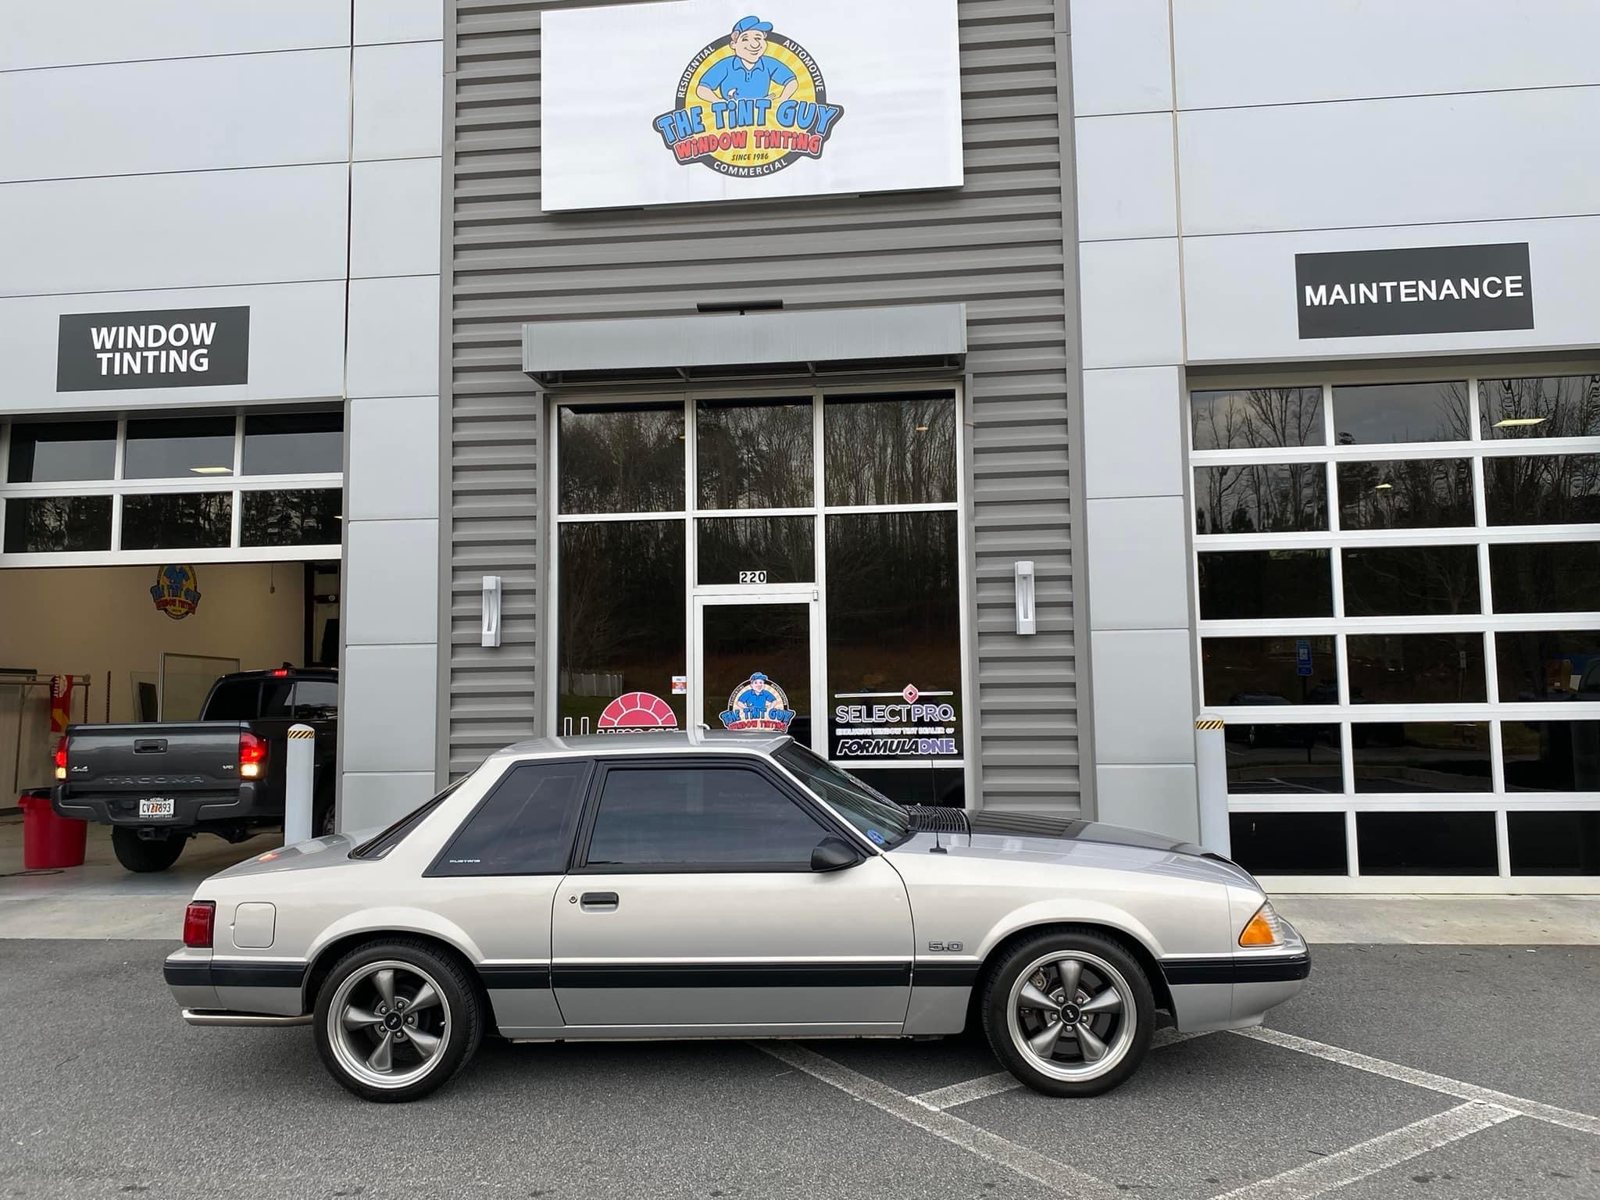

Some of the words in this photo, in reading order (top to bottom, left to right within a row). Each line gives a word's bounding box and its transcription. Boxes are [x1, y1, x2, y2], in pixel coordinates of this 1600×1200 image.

[677, 45, 716, 98] RESIDENTIAL
[783, 39, 824, 93] AUTOMOTIVE
[656, 105, 706, 144] THE
[775, 99, 838, 135] GUY
[713, 159, 788, 176] COMMERCIAL
[731, 153, 752, 162] SINCE
[753, 153, 769, 161] 1986
[1304, 275, 1525, 307] MAINTENANCE
[90, 322, 217, 350] WINDOW
[96, 349, 209, 375] TINTING
[740, 571, 766, 583] 220
[103, 775, 205, 785] TACOMA
[928, 940, 964, 952] 5.0
